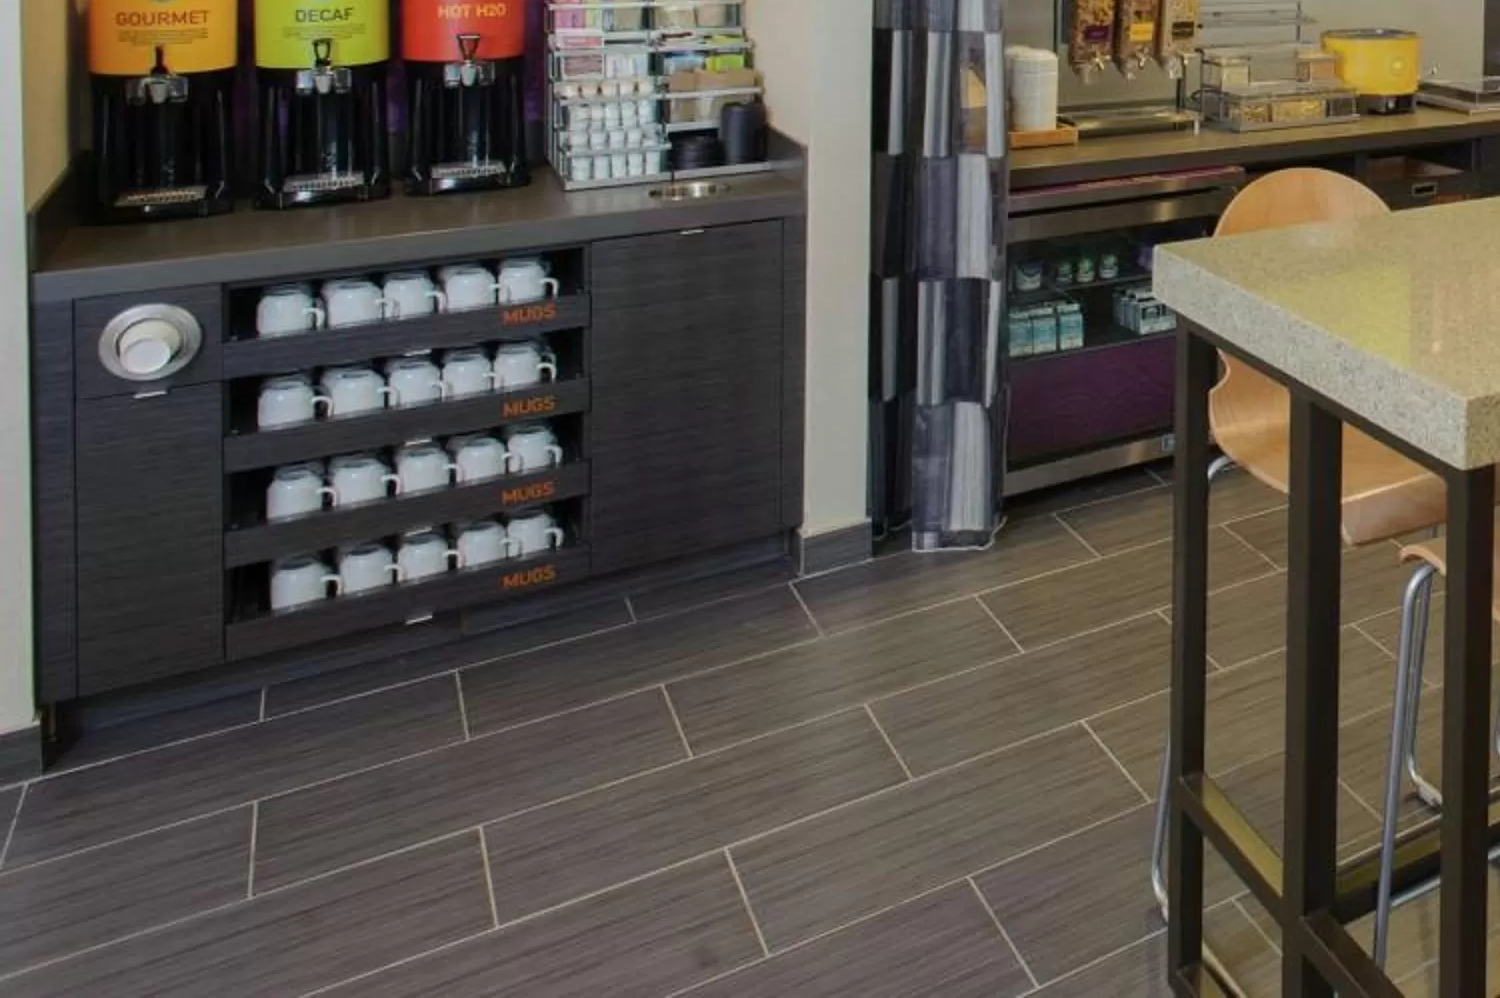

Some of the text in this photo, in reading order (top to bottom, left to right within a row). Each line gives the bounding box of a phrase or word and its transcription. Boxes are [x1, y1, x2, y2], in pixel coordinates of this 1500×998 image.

[115, 9, 212, 27] GOURMET
[294, 6, 355, 24] DECAF
[437, 3, 472, 19] HOT
[504, 304, 555, 323] MUGS
[503, 396, 555, 417] MUGS
[502, 482, 554, 503] MUGS
[501, 568, 553, 587] MUGS
